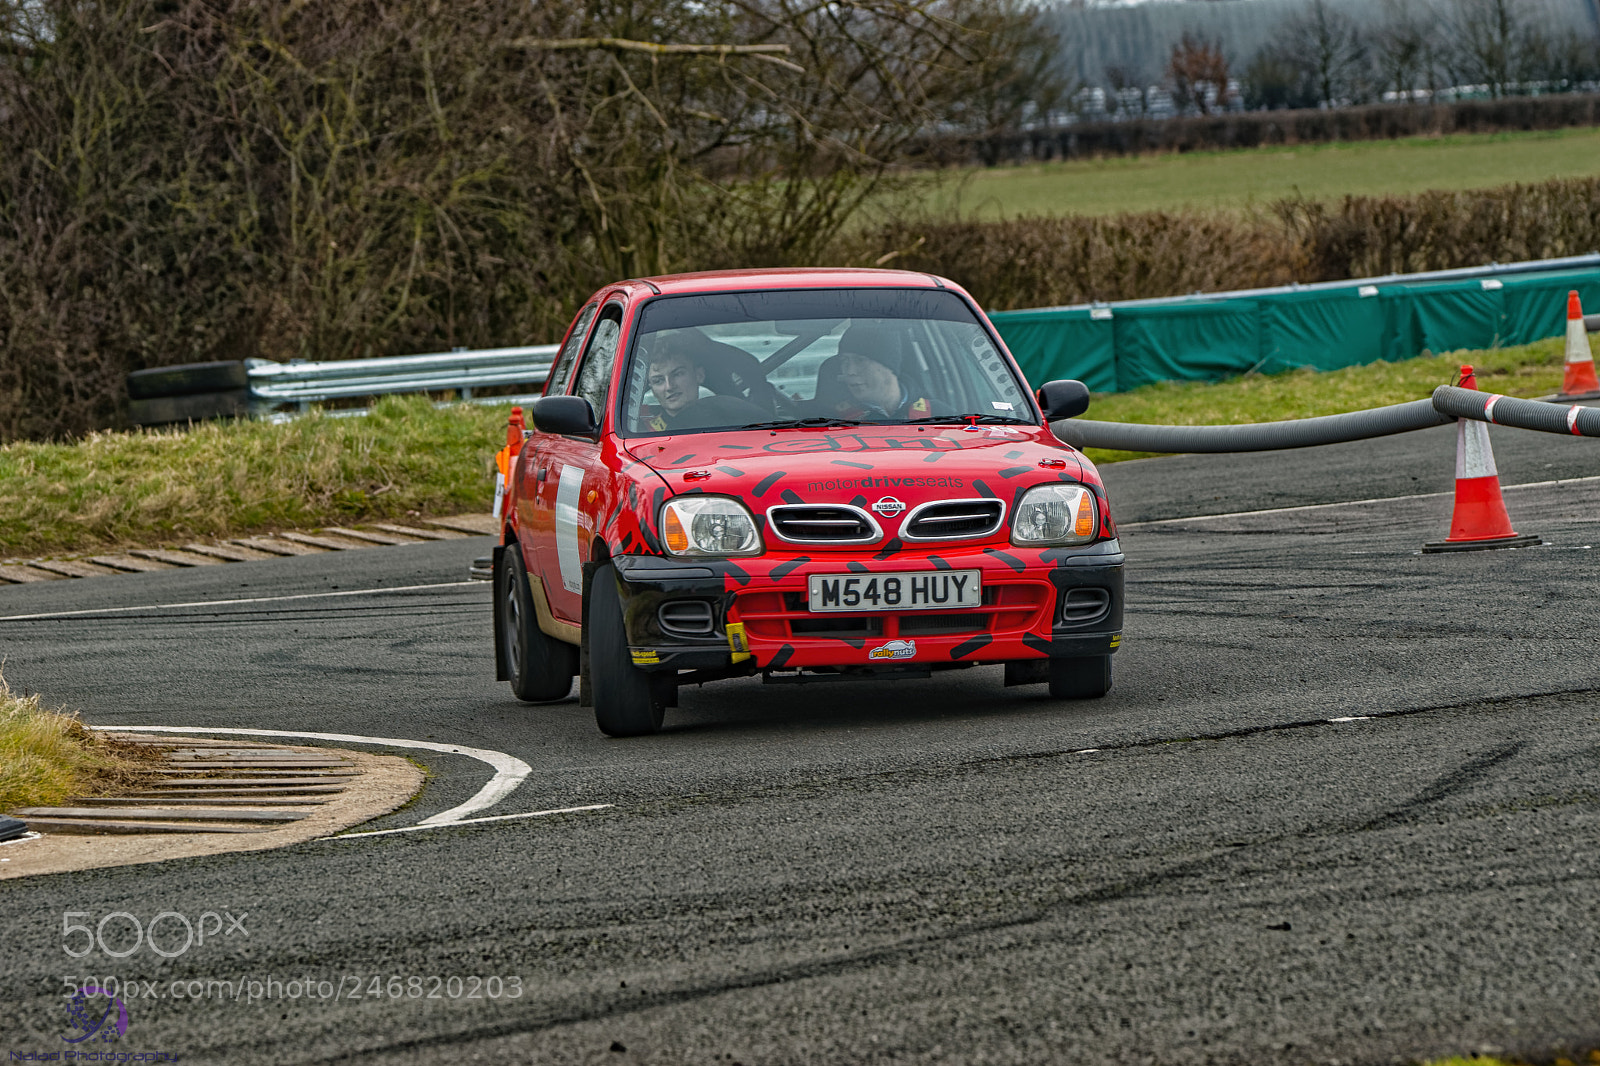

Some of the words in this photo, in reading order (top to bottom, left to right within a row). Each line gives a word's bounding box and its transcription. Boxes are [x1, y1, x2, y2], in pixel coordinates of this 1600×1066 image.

[807, 475, 964, 493] motordriveseats
[821, 578, 901, 607] M548
[911, 574, 968, 604] HUY
[873, 645, 914, 658] rallynuts
